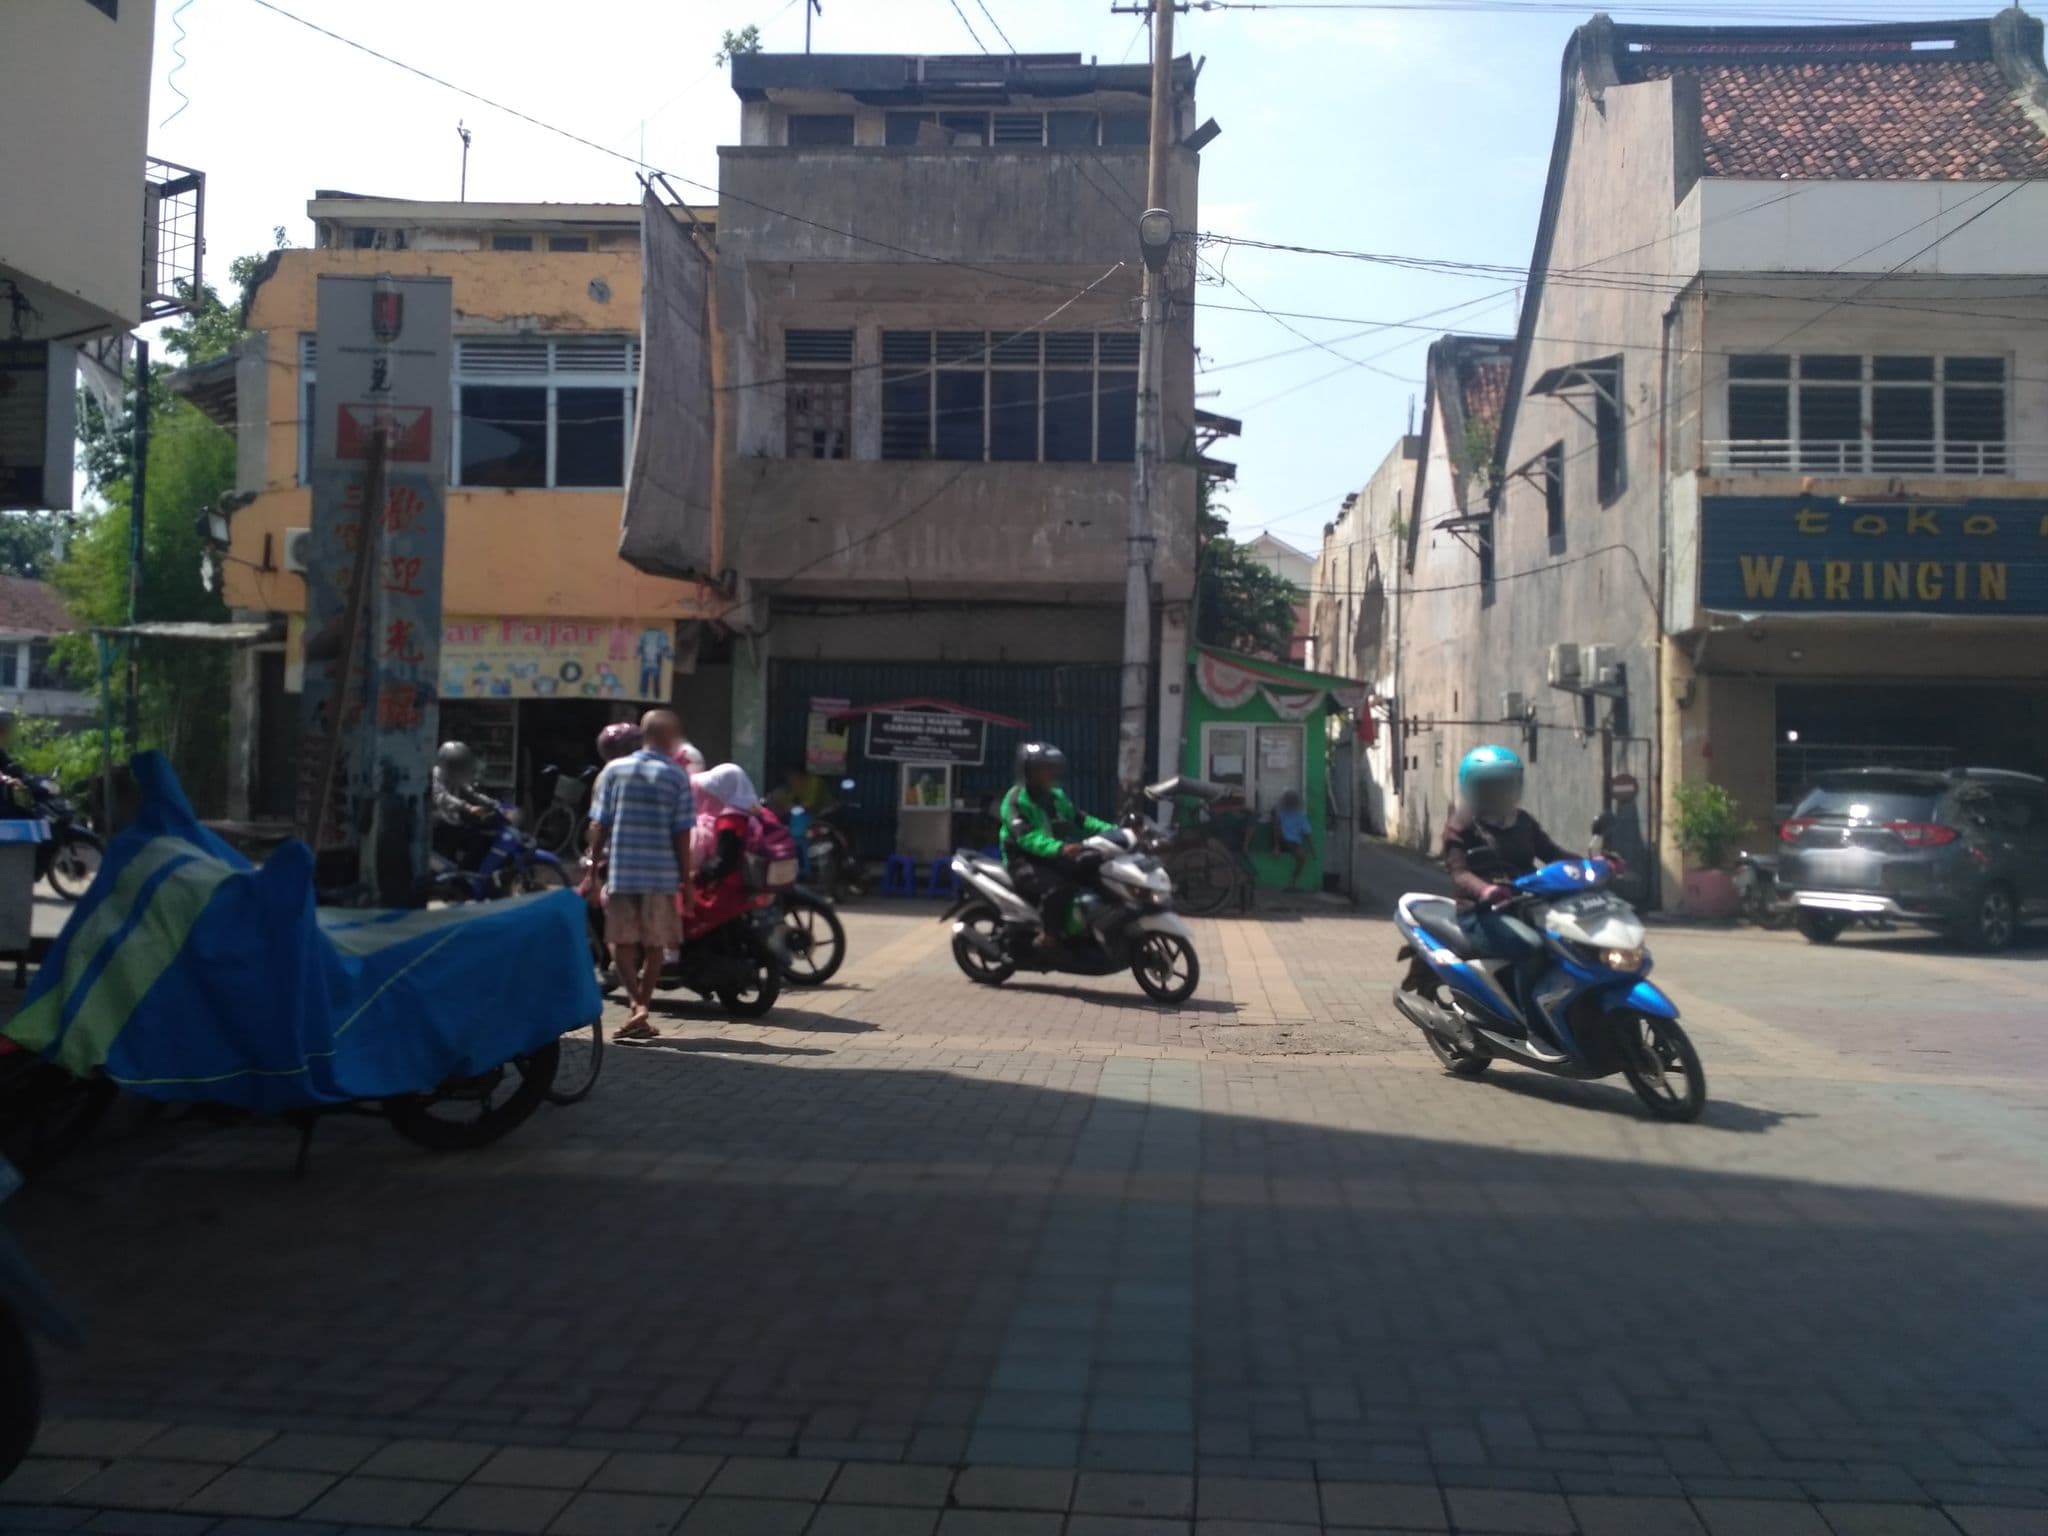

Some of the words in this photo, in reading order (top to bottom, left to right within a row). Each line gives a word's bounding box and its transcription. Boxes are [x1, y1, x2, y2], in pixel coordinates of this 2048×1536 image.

[1795, 506, 1998, 536] toko
[1740, 555, 2007, 601] WARINGIN
[445, 623, 489, 644] ar
[501, 616, 602, 648] Fajar
